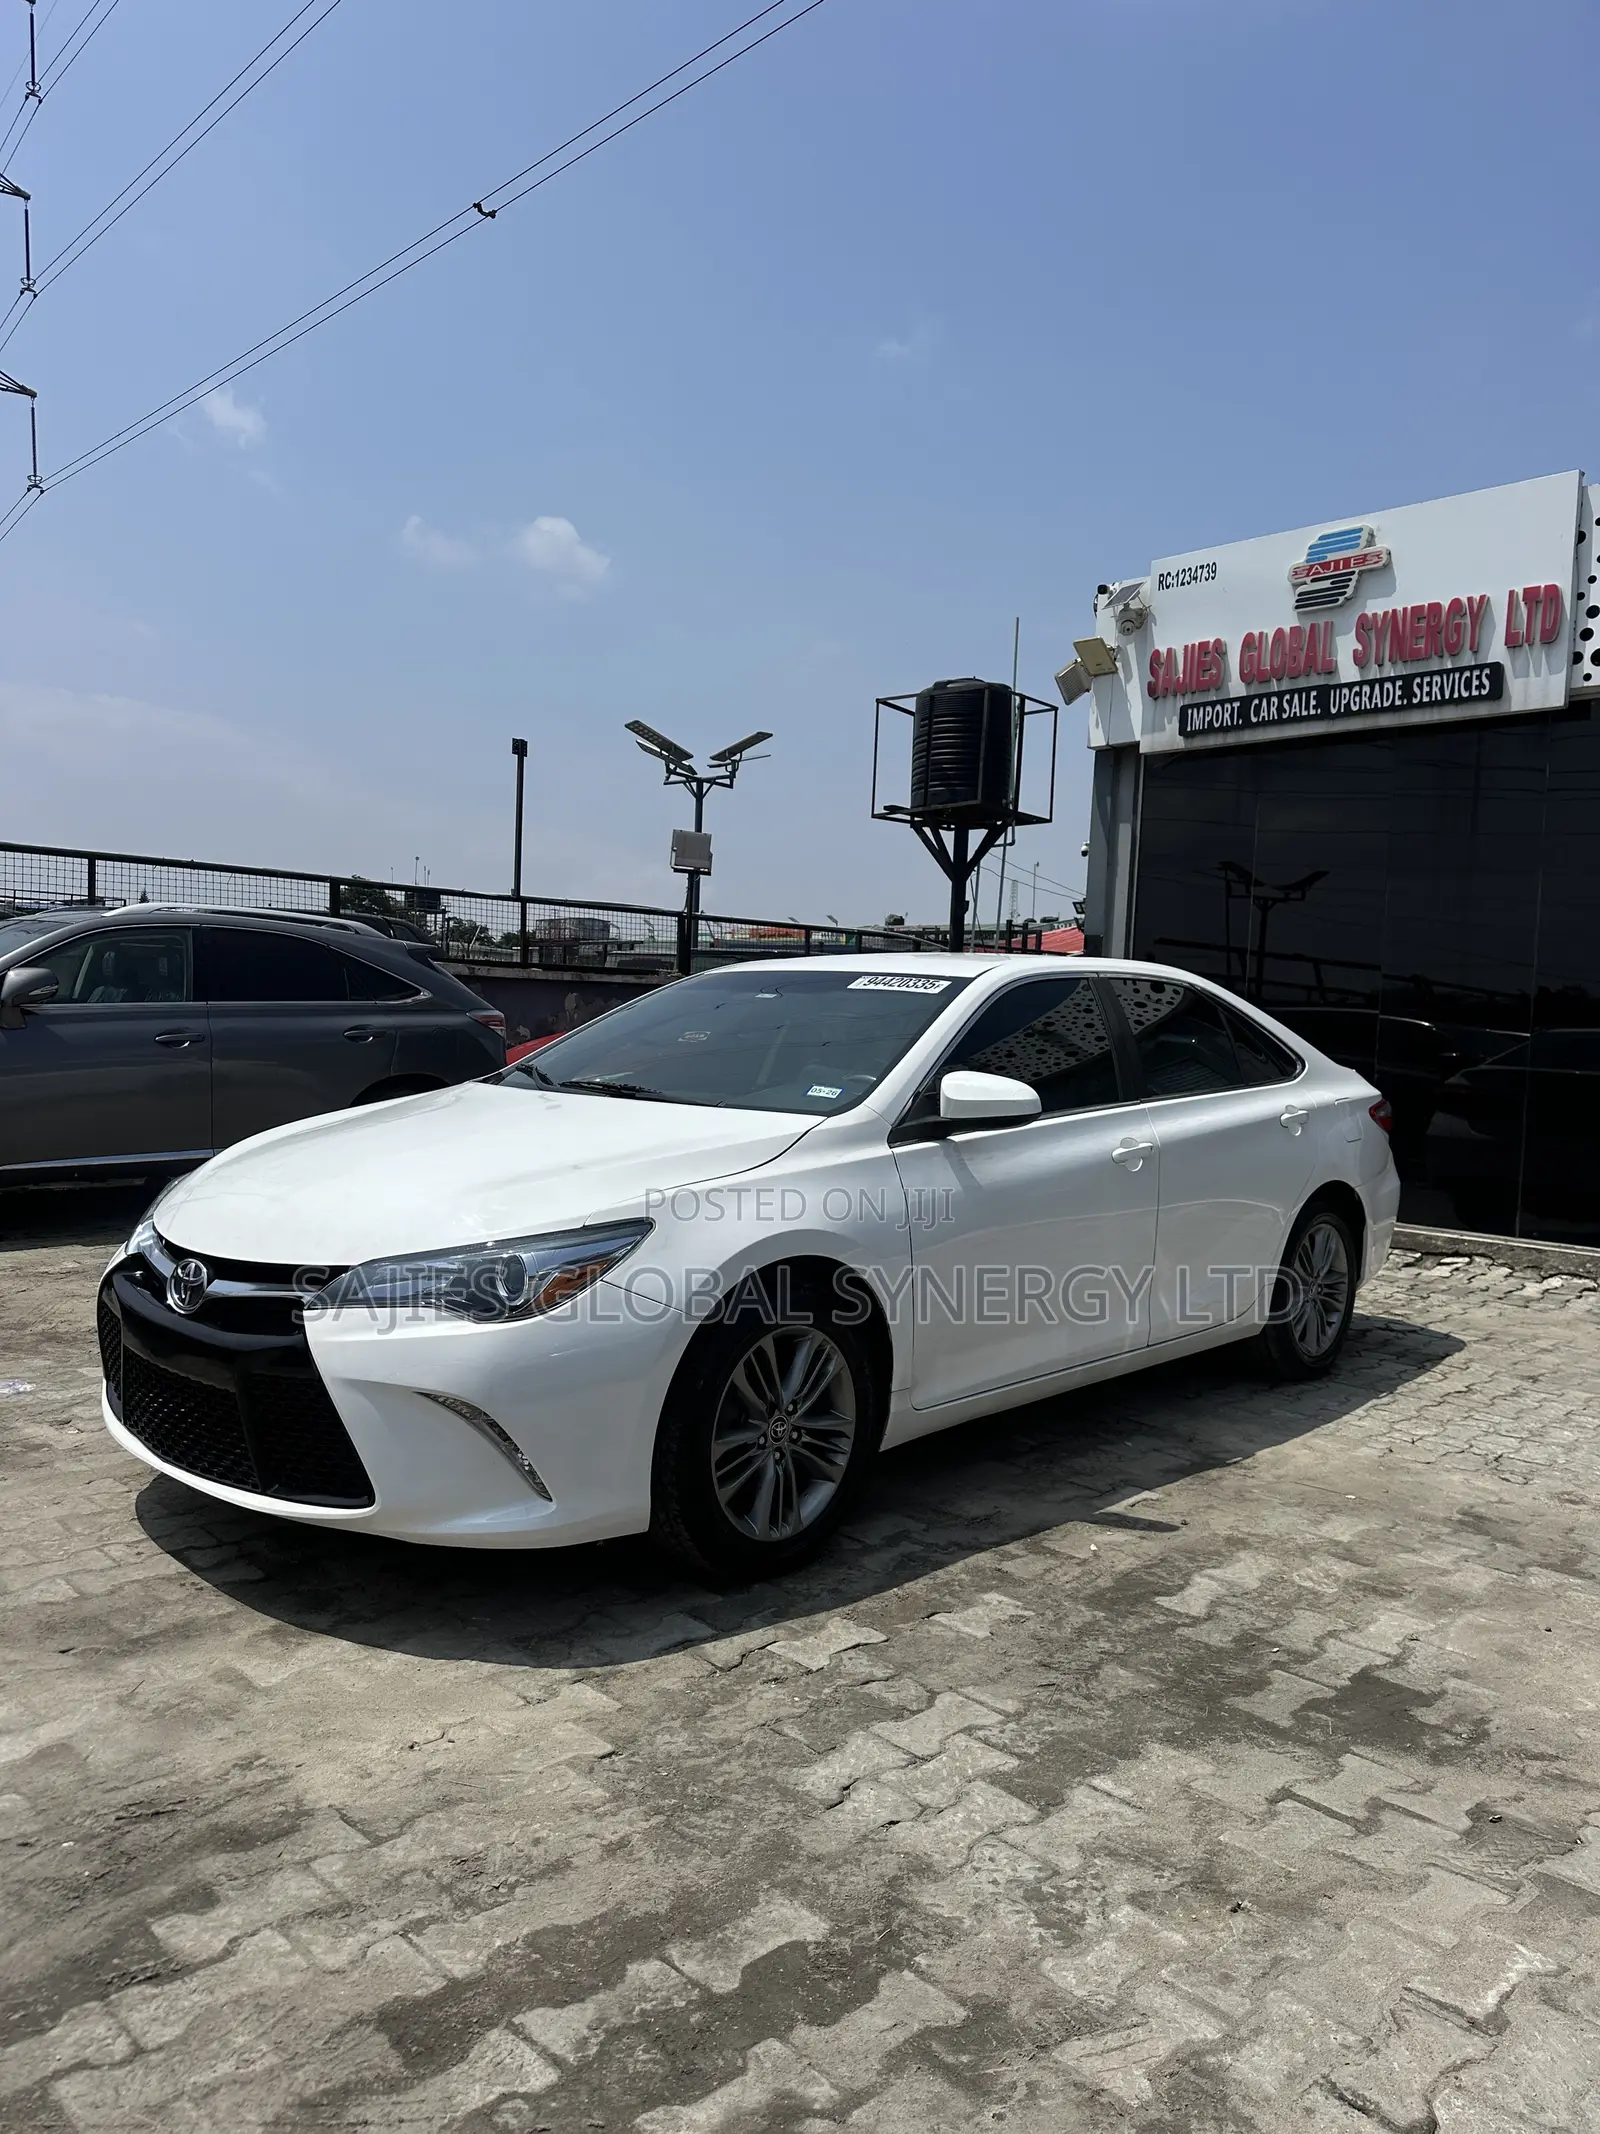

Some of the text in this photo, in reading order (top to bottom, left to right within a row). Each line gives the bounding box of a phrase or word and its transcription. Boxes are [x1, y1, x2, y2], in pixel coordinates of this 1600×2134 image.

[1157, 561, 1217, 592] RC:1234739
[1291, 550, 1384, 580] SAJIES
[1147, 583, 1562, 700] SAJIES GLOBAL SYNERGY LTD
[1186, 667, 1491, 732] IMPORT. CAR SALE. UPGRADE. SERVICES
